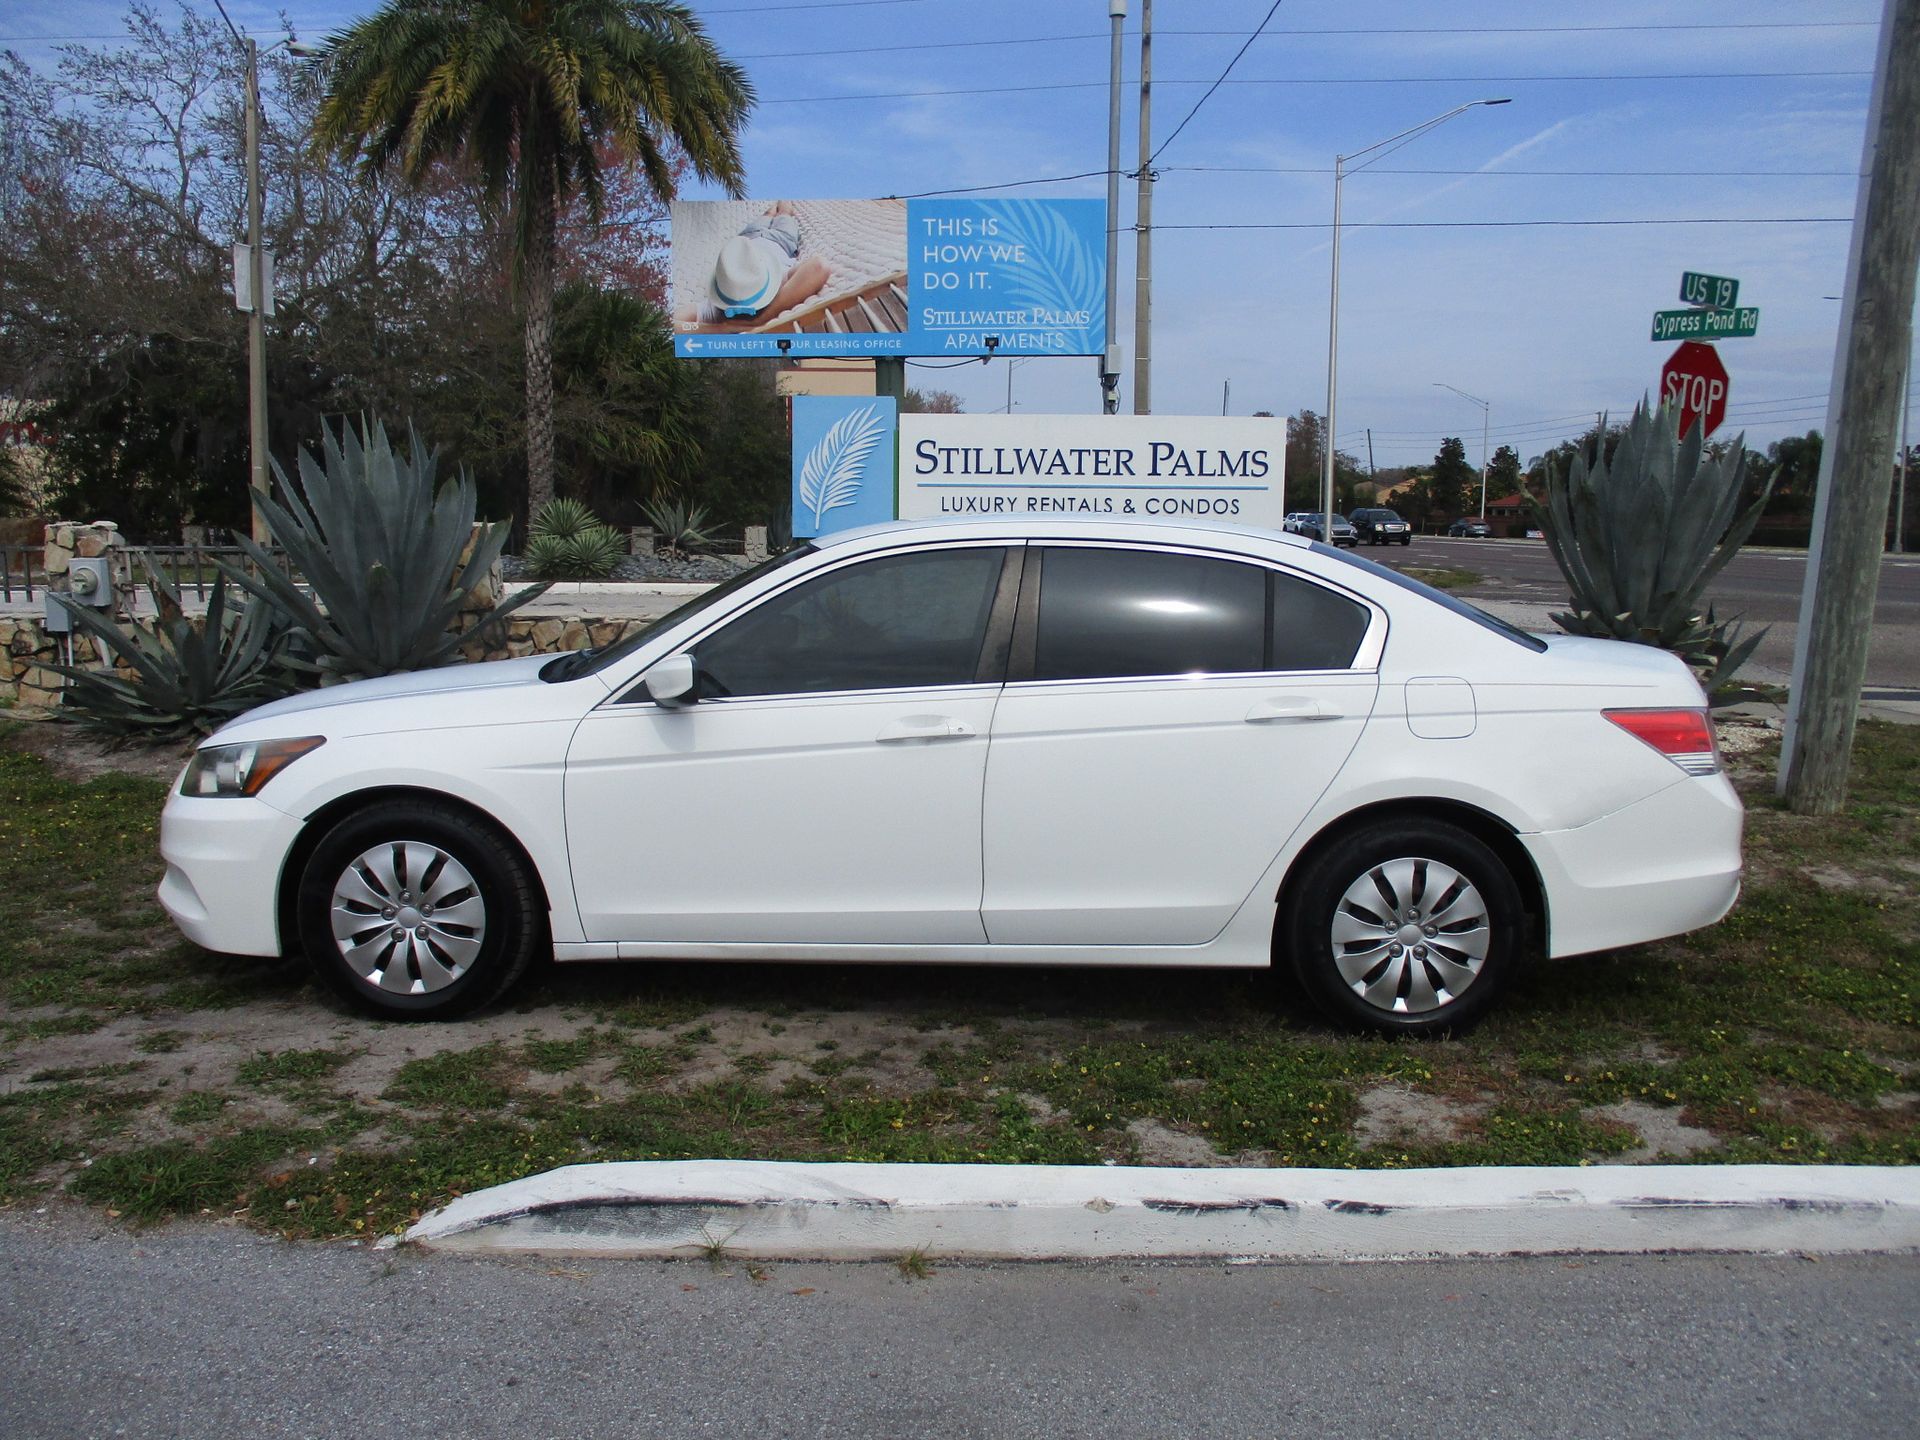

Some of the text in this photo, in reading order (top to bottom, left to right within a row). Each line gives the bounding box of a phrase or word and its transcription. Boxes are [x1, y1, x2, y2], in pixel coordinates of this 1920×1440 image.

[922, 218, 999, 236] THIS IS
[924, 245, 1026, 263] HOW WE
[924, 272, 993, 290] DO IT.
[1686, 275, 1733, 307] US 19
[923, 308, 1090, 326] STILLWATER PALMS
[1654, 309, 1757, 339] Cypress Pond Rd
[707, 340, 737, 350] TURN
[741, 340, 765, 350] LEFT
[768, 340, 780, 350] T
[815, 339, 860, 349] LEASING
[864, 339, 902, 349] OFFICE
[1664, 371, 1724, 415] STOP
[915, 439, 1270, 478] STILLWATER PALMS
[941, 496, 1241, 515] LUXURY RENTALS & CONDOS
